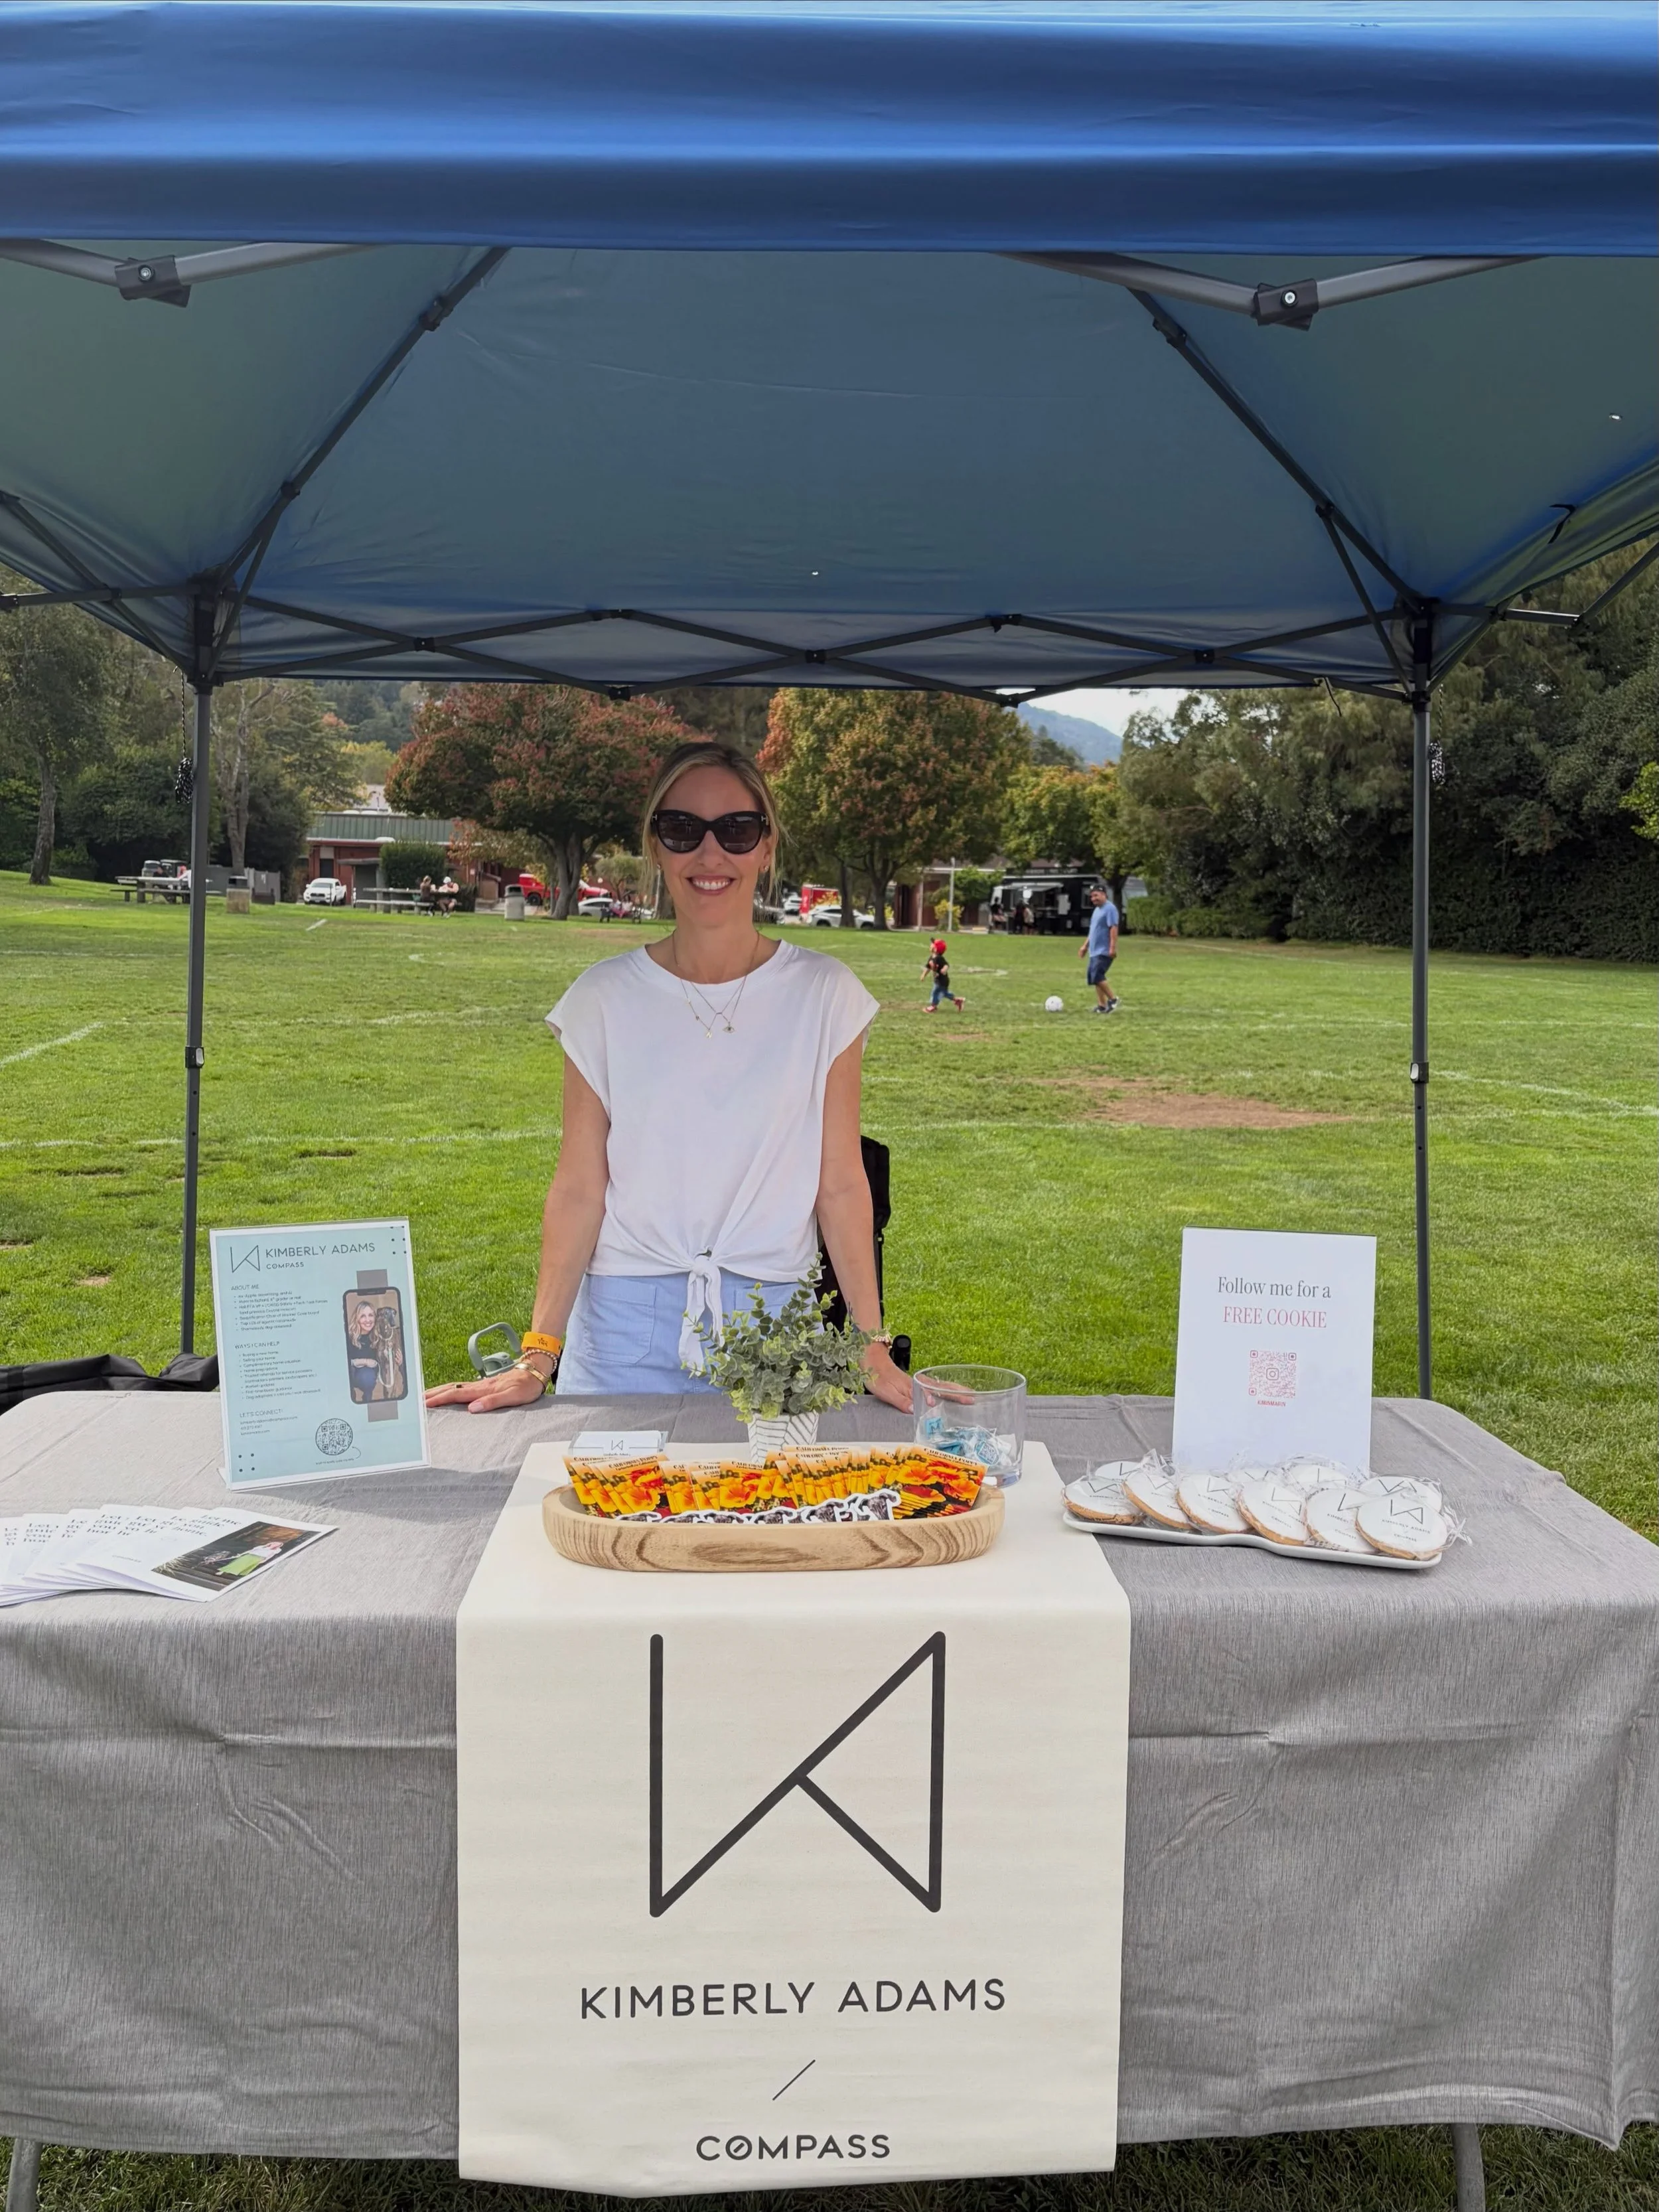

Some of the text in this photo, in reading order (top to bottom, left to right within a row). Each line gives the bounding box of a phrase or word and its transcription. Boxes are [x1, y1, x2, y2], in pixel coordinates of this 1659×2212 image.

[265, 1242, 376, 1258] KIMBERLY ADAMS
[1218, 1276, 1331, 1298] Follow me for a
[1224, 1307, 1327, 1328] FREE COOKIE
[581, 1978, 1005, 2020] KIMBERLY ADAMS
[696, 2134, 890, 2161] COMPASS
